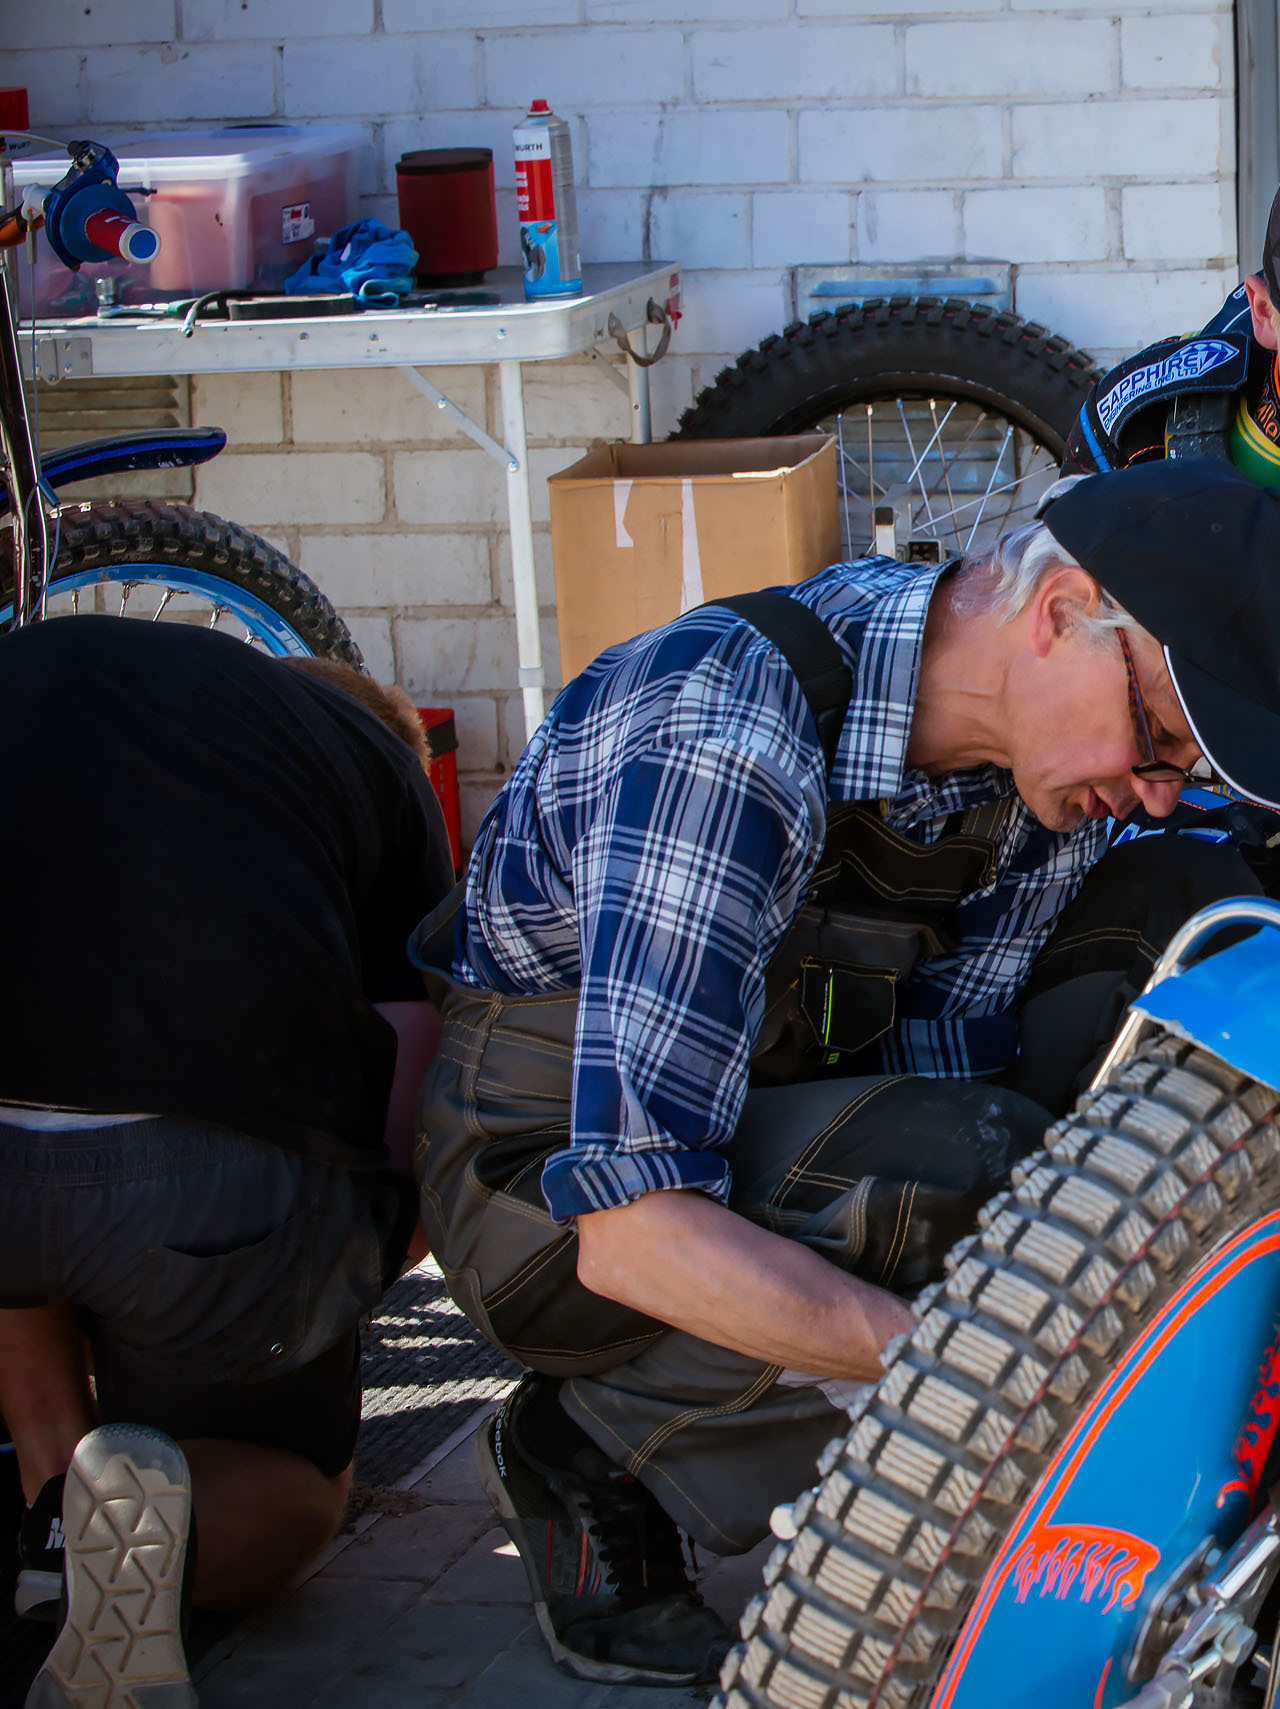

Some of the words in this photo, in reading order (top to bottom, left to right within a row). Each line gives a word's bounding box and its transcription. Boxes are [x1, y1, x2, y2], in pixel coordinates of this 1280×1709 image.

[1099, 352, 1199, 421] SAPPHIRE
[1178, 367, 1198, 377] LTD
[495, 1406, 507, 1478] Reebok
